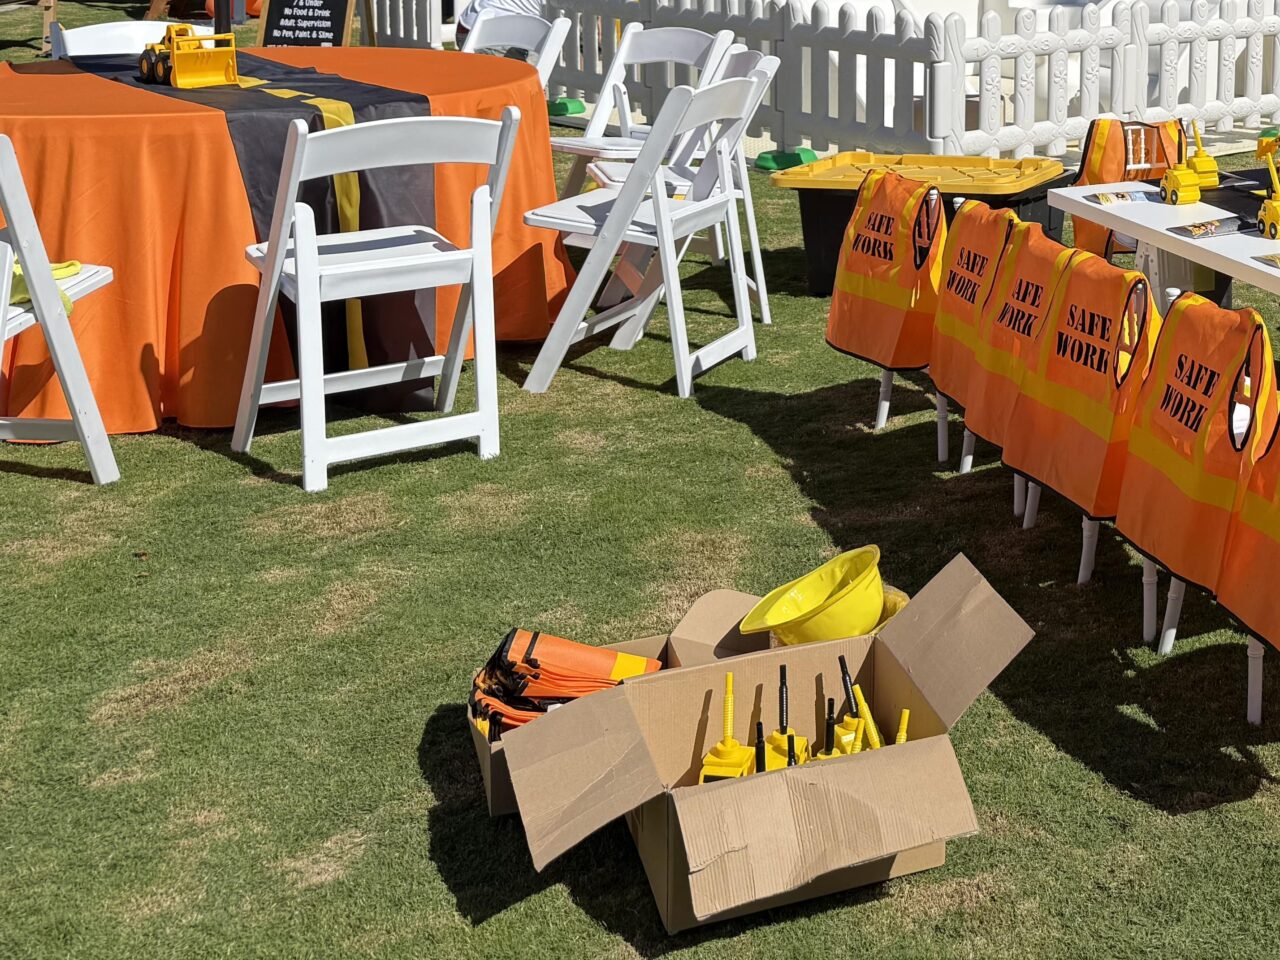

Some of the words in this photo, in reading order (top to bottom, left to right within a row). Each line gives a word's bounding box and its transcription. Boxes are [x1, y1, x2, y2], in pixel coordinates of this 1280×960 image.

[284, 7, 292, 15] No
[293, 8, 308, 16] Food
[308, 8, 313, 16] &
[314, 9, 331, 17] Drink
[305, 0, 323, 7] Under
[273, 29, 281, 37] No
[312, 30, 317, 38] &
[318, 31, 334, 39] Slime
[280, 18, 295, 26] Adult
[297, 19, 331, 28] Supervision
[864, 211, 895, 236] SAFE
[852, 232, 894, 261] WORK
[957, 246, 988, 278] SAFE
[946, 270, 981, 305] WORK
[1012, 278, 1044, 308] AFE
[1066, 304, 1113, 343] SAFE
[1056, 330, 1111, 375] WORK
[1174, 353, 1220, 399] SAFE
[1160, 383, 1208, 433] WORK
